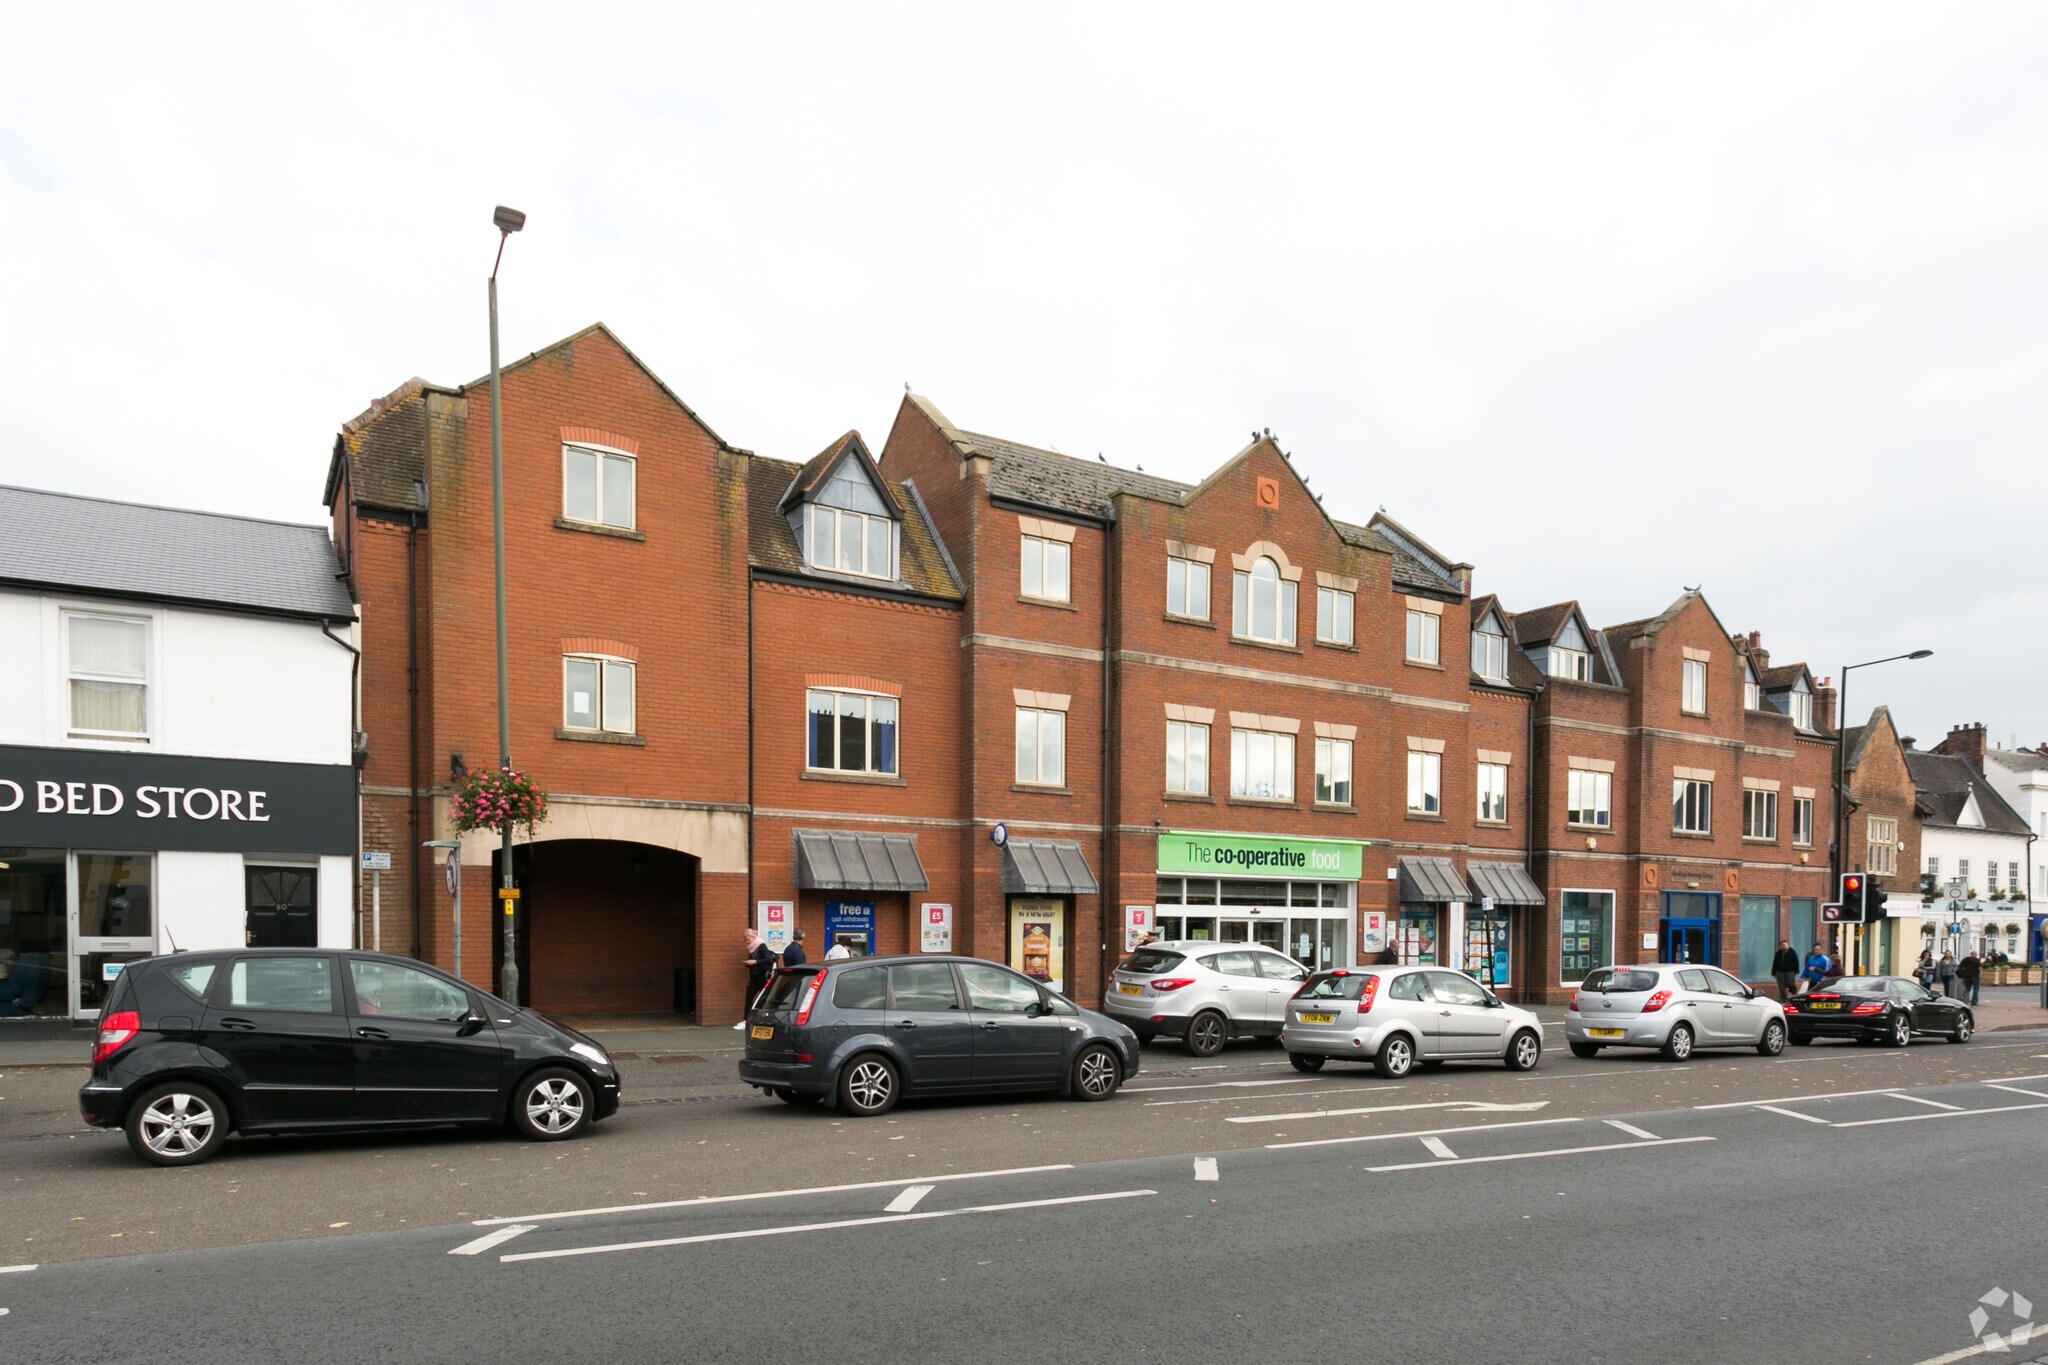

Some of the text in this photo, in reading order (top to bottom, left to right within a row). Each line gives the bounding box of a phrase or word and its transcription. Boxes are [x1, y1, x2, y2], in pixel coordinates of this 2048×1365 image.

[36, 780, 124, 816] BED
[136, 785, 270, 822] STORE
[1185, 841, 1211, 864] The
[1311, 848, 1340, 870] food
[770, 909, 781, 918] £3
[839, 903, 862, 915] free
[931, 911, 942, 920] £5
